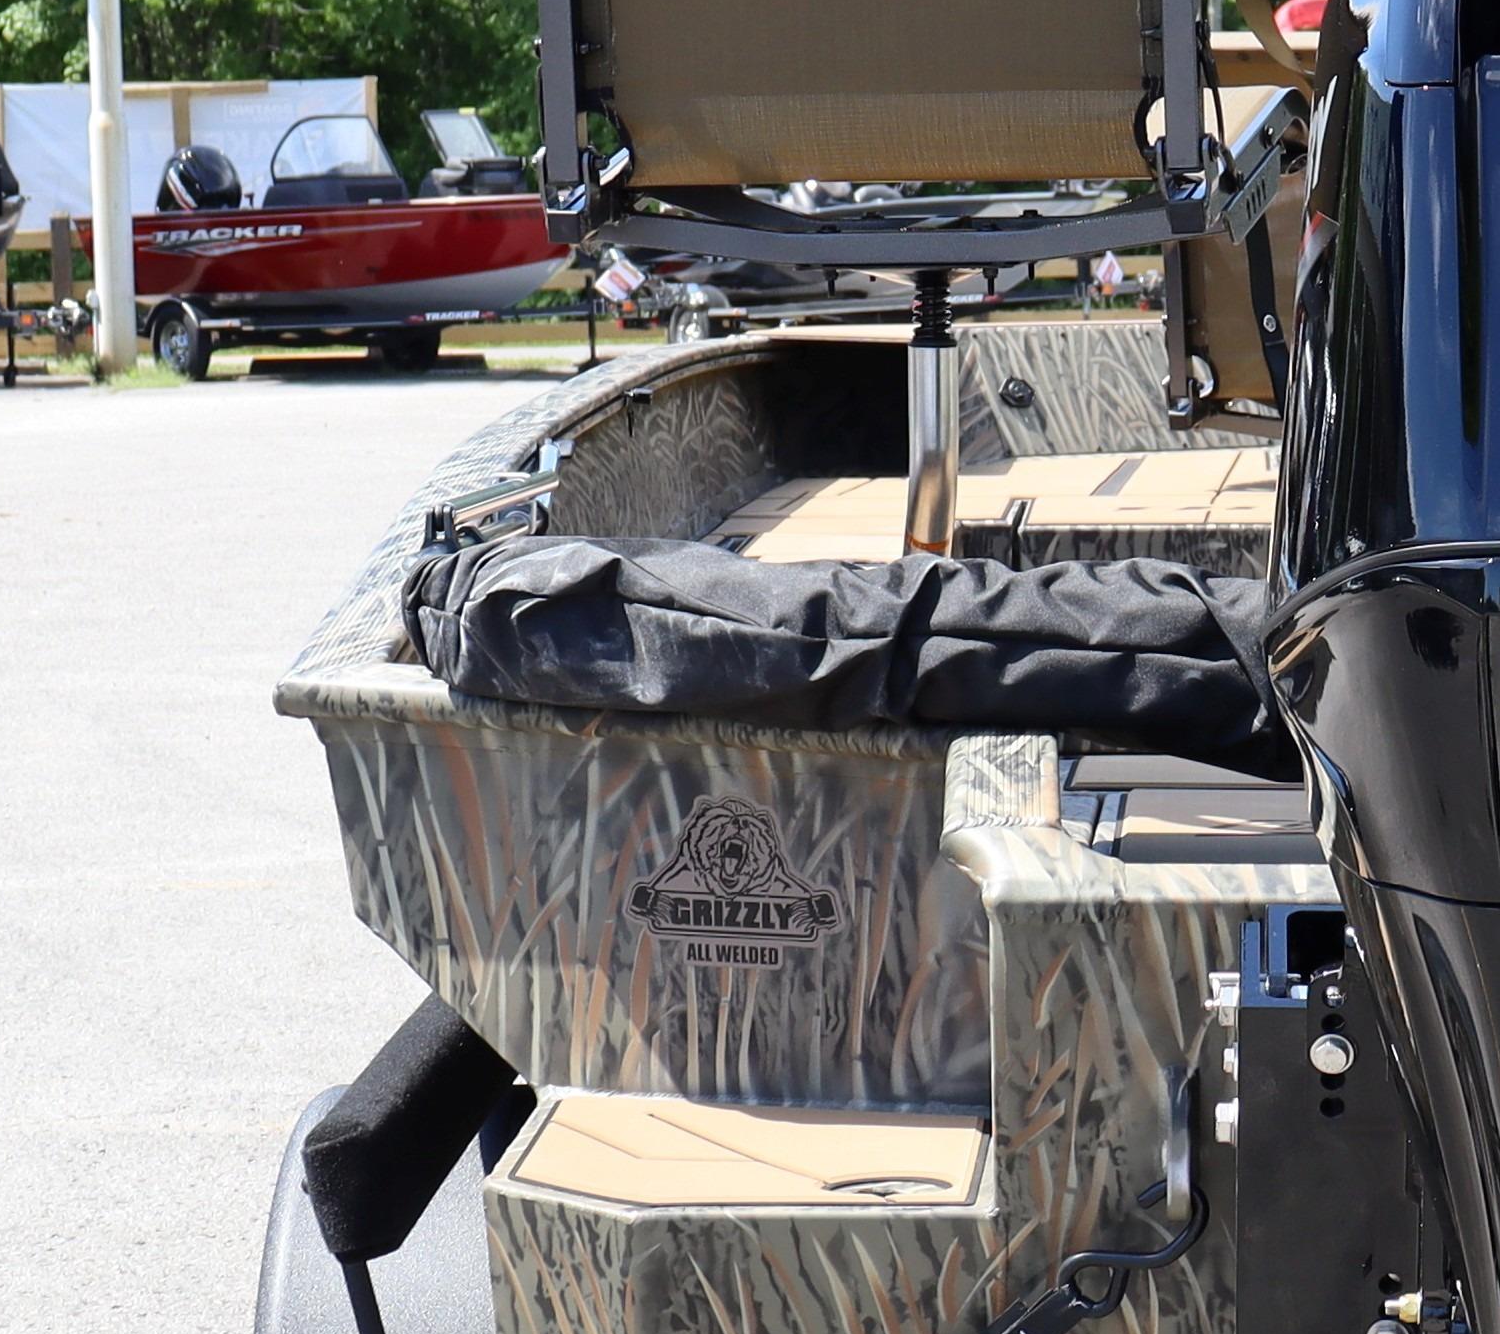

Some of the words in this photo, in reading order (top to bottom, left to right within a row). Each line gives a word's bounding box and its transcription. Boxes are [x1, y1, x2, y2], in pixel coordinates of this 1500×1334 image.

[152, 224, 303, 244] TRACKER
[425, 310, 480, 321] TRACKER
[671, 897, 793, 930] GRIZZLY
[686, 943, 712, 962] ALL
[716, 944, 779, 965] WELDED
